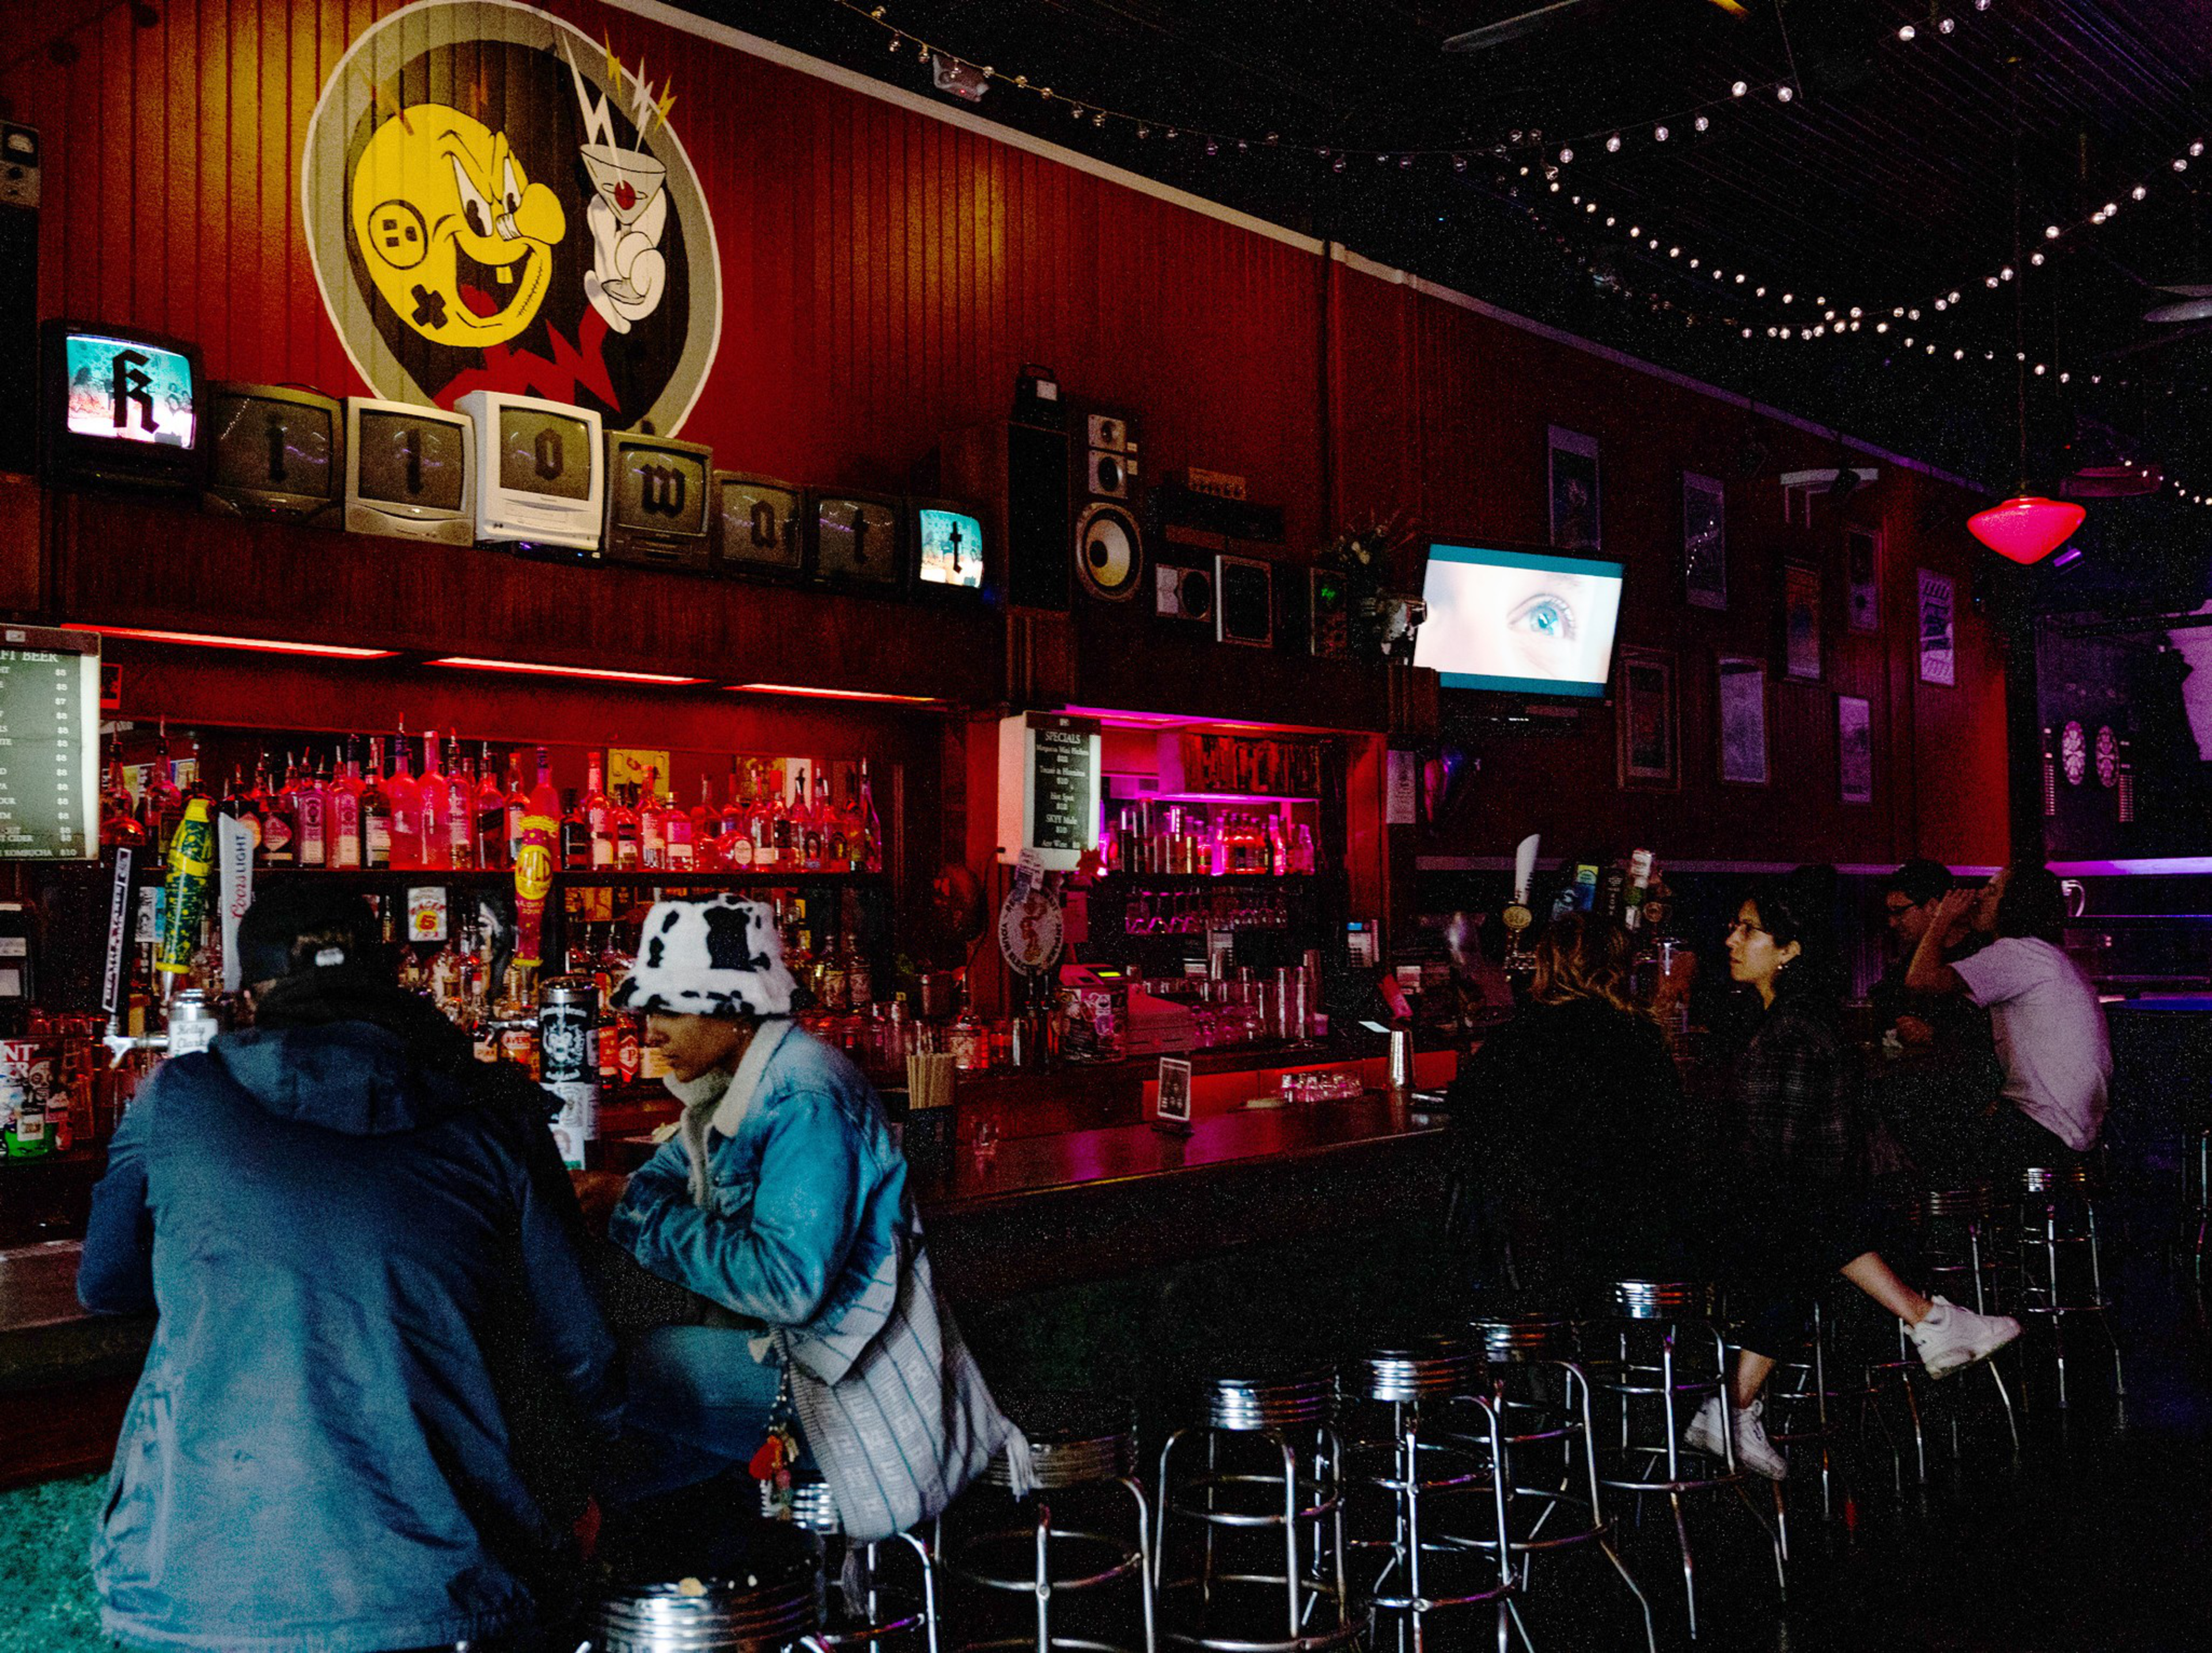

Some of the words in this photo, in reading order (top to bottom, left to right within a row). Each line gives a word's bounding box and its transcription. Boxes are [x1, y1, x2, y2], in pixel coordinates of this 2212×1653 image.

[1045, 731, 1081, 744] SPECIALS
[235, 835, 248, 873] LIGHT
[231, 874, 248, 919] Coors
[420, 915, 435, 930] 5
[1001, 923, 1012, 951] YOUR
